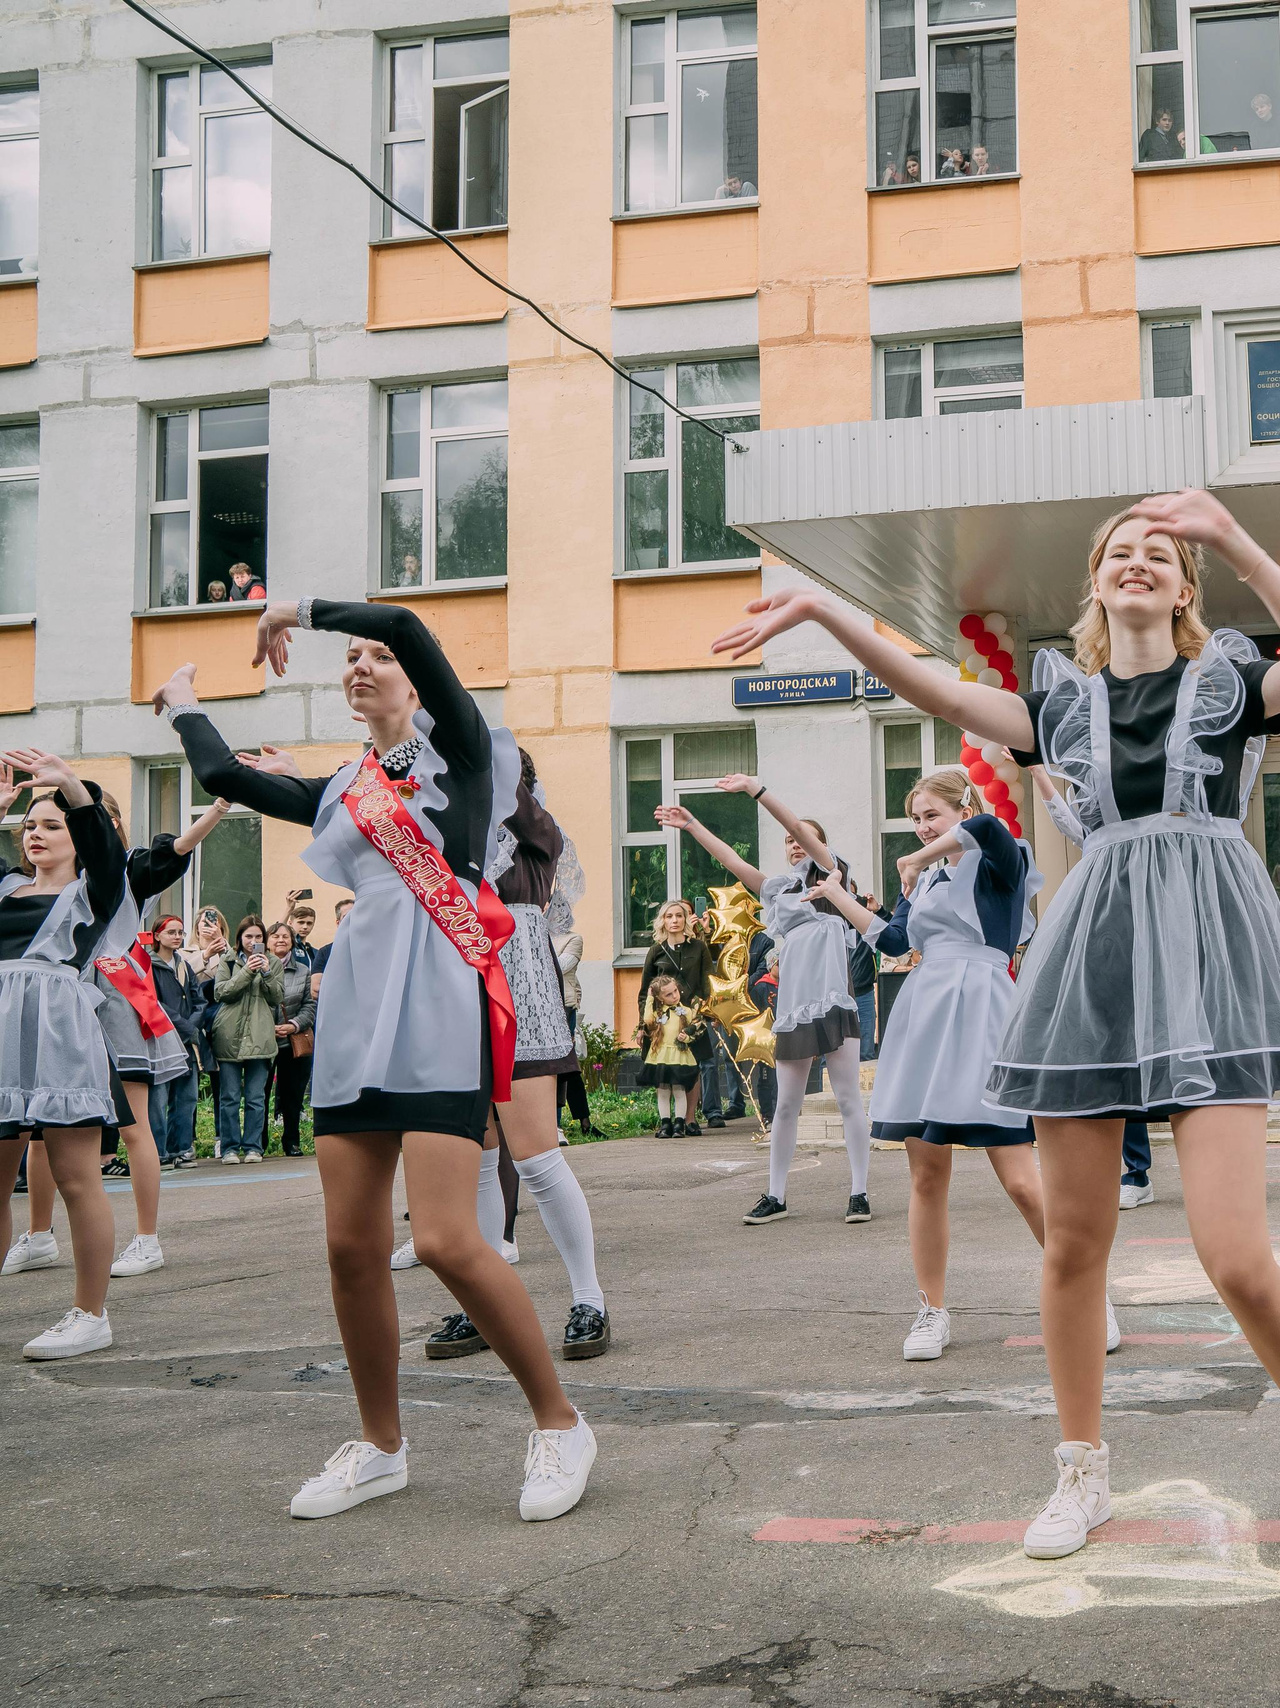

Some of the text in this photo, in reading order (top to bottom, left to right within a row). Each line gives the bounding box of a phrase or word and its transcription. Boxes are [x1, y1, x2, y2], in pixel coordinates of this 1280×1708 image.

[748, 676, 837, 692] НОВГОРОДСКАЯ
[357, 789, 492, 960] Выпускник 2022
